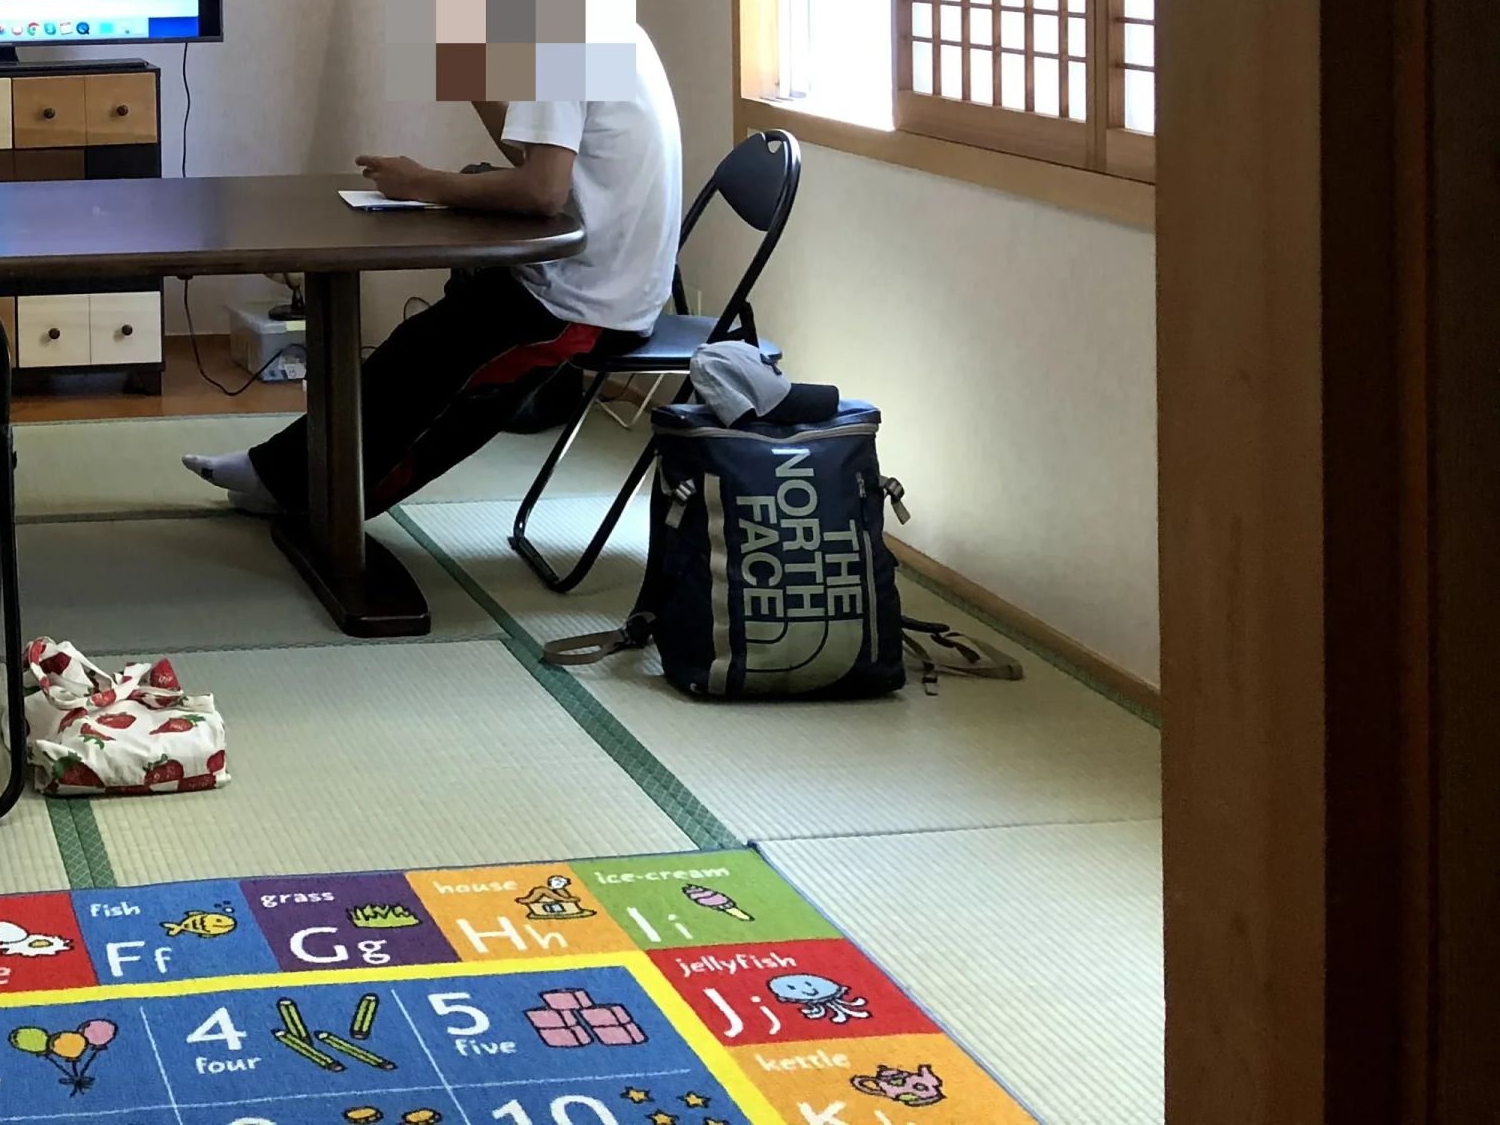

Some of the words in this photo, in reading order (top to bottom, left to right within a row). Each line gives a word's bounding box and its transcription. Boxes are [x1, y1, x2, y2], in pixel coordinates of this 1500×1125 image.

[771, 448, 827, 617] NORTH
[736, 496, 785, 617] FACE
[823, 519, 863, 616] THE
[594, 864, 730, 885] ice-cream
[433, 878, 518, 895] house
[90, 901, 140, 918] fish
[260, 889, 335, 908] grass
[675, 952, 798, 977] jellyfish
[427, 991, 491, 1037] 5
[186, 1006, 247, 1051] 4
[455, 1037, 518, 1057] five
[195, 1054, 262, 1075] four
[755, 1049, 851, 1072] kettle
